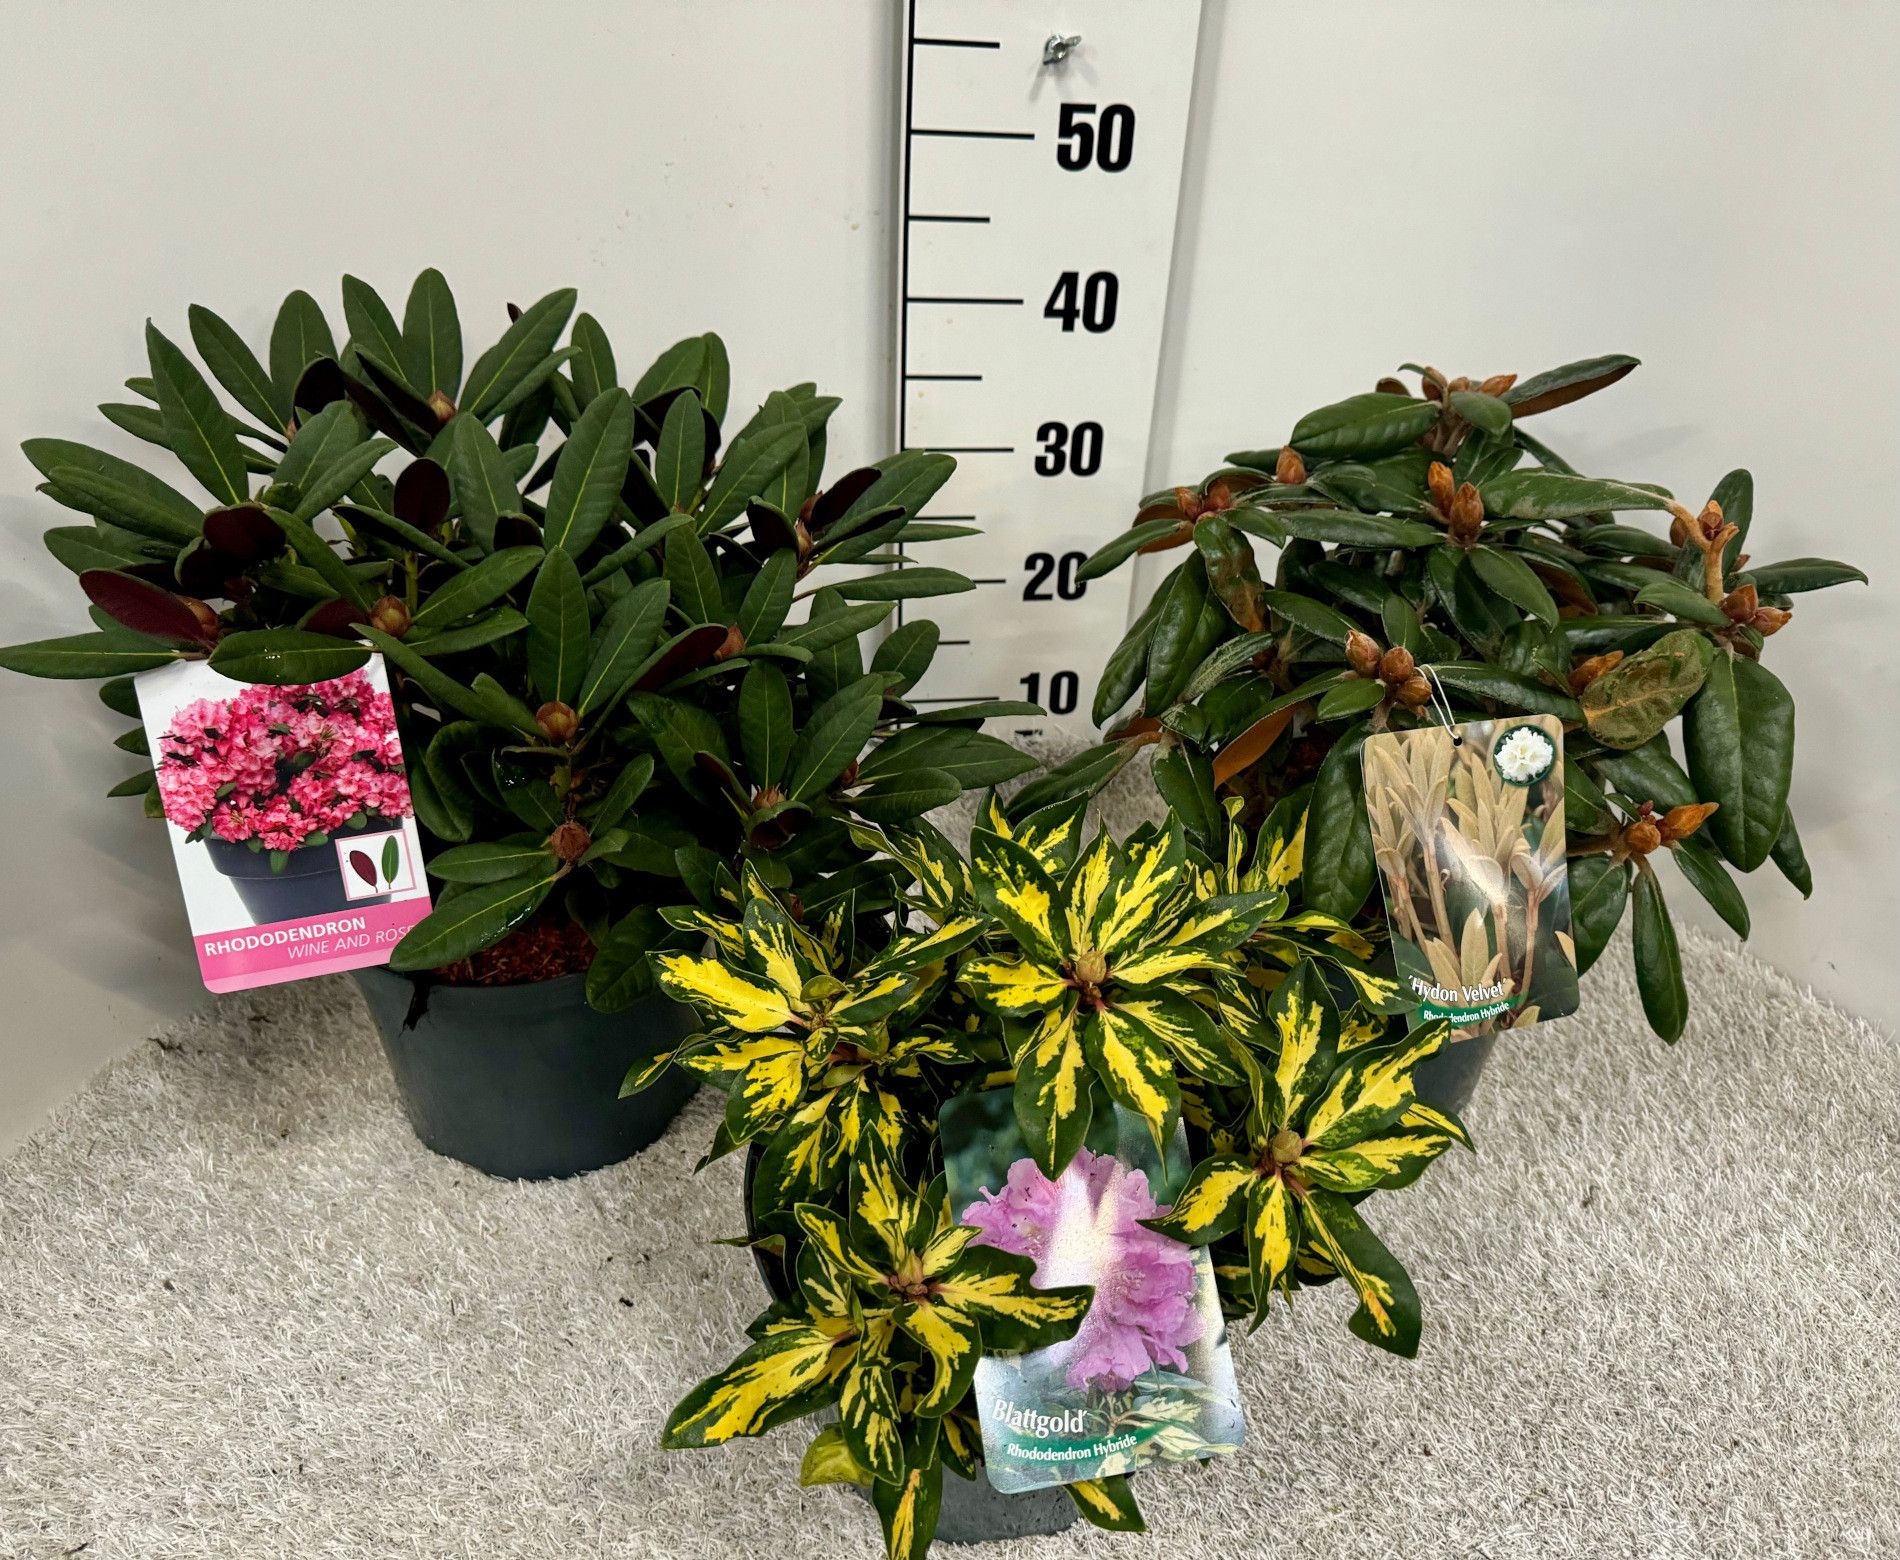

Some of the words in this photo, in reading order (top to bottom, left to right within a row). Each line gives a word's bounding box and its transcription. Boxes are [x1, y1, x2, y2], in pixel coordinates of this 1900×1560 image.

[1056, 103, 1136, 172] 50
[1044, 271, 1119, 333] 40
[1034, 421, 1104, 477] 30
[1022, 551, 1088, 601] 20
[1019, 670, 1079, 715] 10
[204, 916, 366, 956] RHODODENDRON
[287, 941, 329, 959] WINE
[334, 933, 370, 950] AND
[1480, 1002, 1510, 1020] Hybride
[1007, 1442, 1092, 1461] Rhododendron
[1093, 1433, 1138, 1458] Hybride
